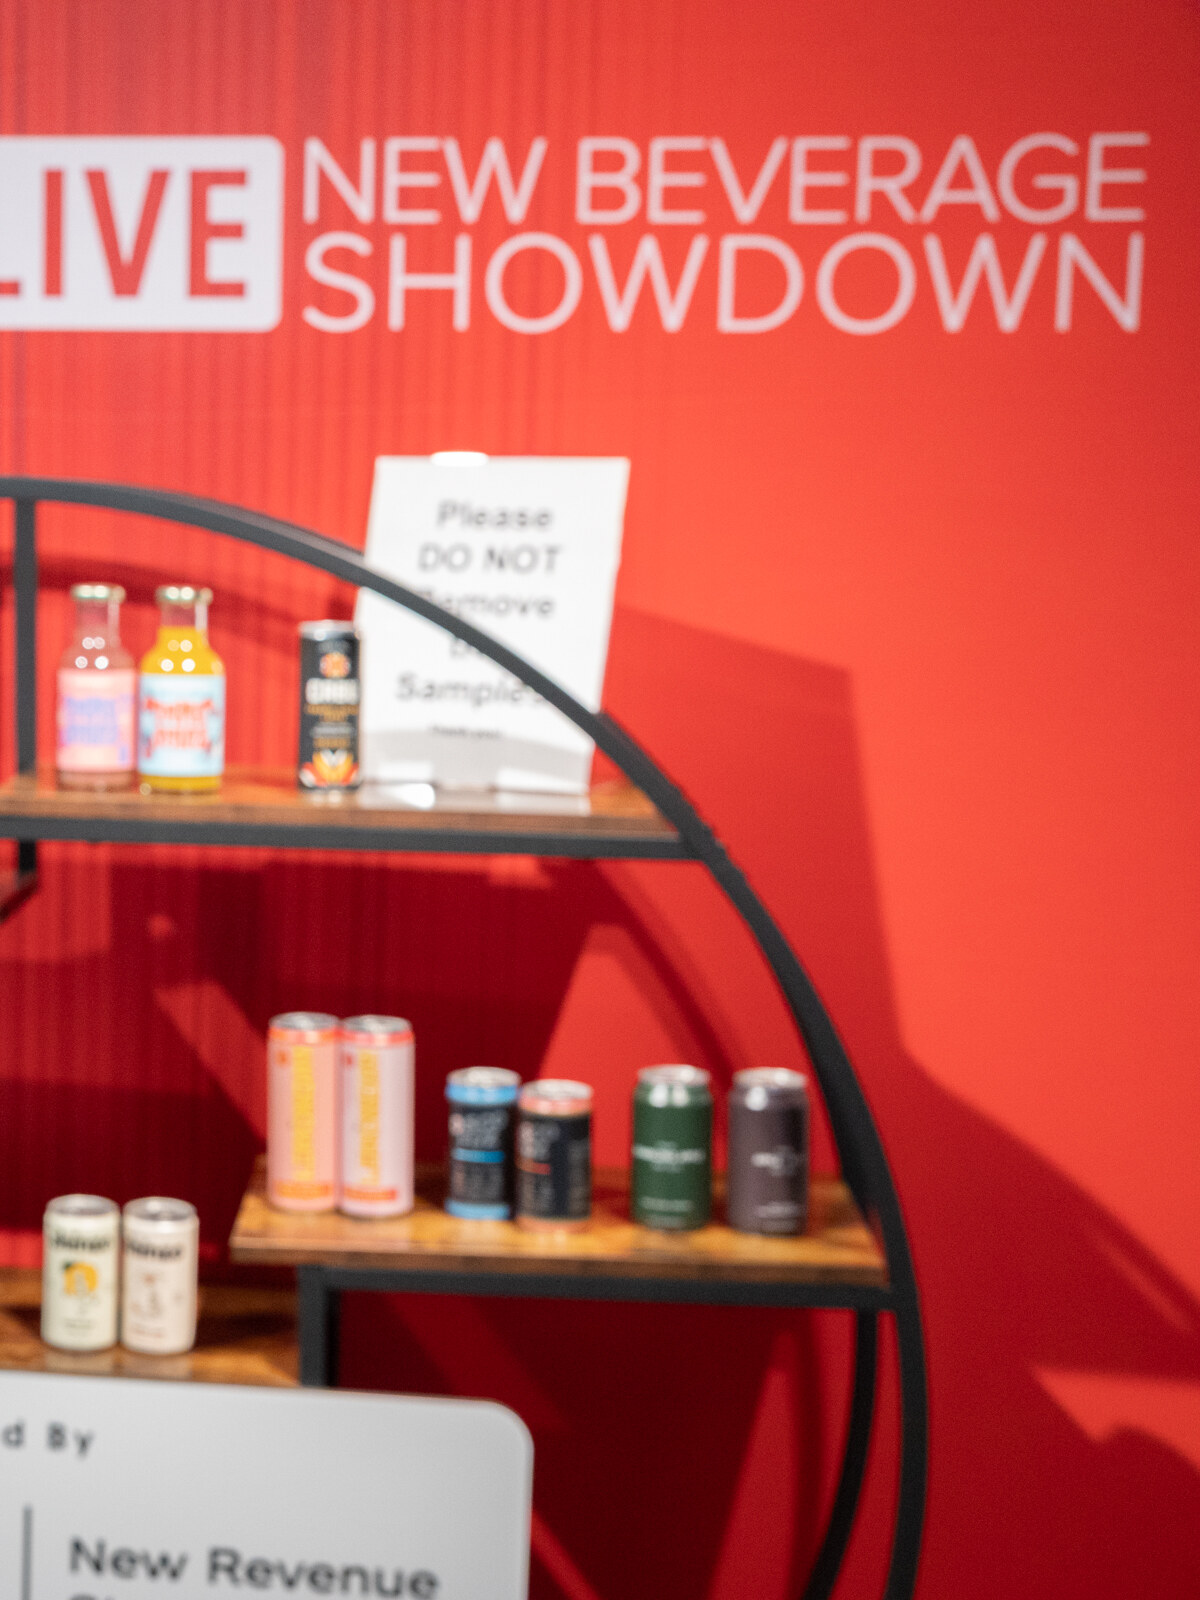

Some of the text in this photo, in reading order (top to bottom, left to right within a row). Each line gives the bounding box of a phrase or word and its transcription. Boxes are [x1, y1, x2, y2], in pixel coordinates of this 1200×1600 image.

[303, 131, 1150, 226] NEW BEVERAGE
[302, 231, 1145, 335] SHOWDOWN
[436, 498, 554, 531] Please
[417, 542, 565, 577] DO NOT
[45, 1420, 95, 1460] By
[68, 1536, 440, 1600] New Revenue
